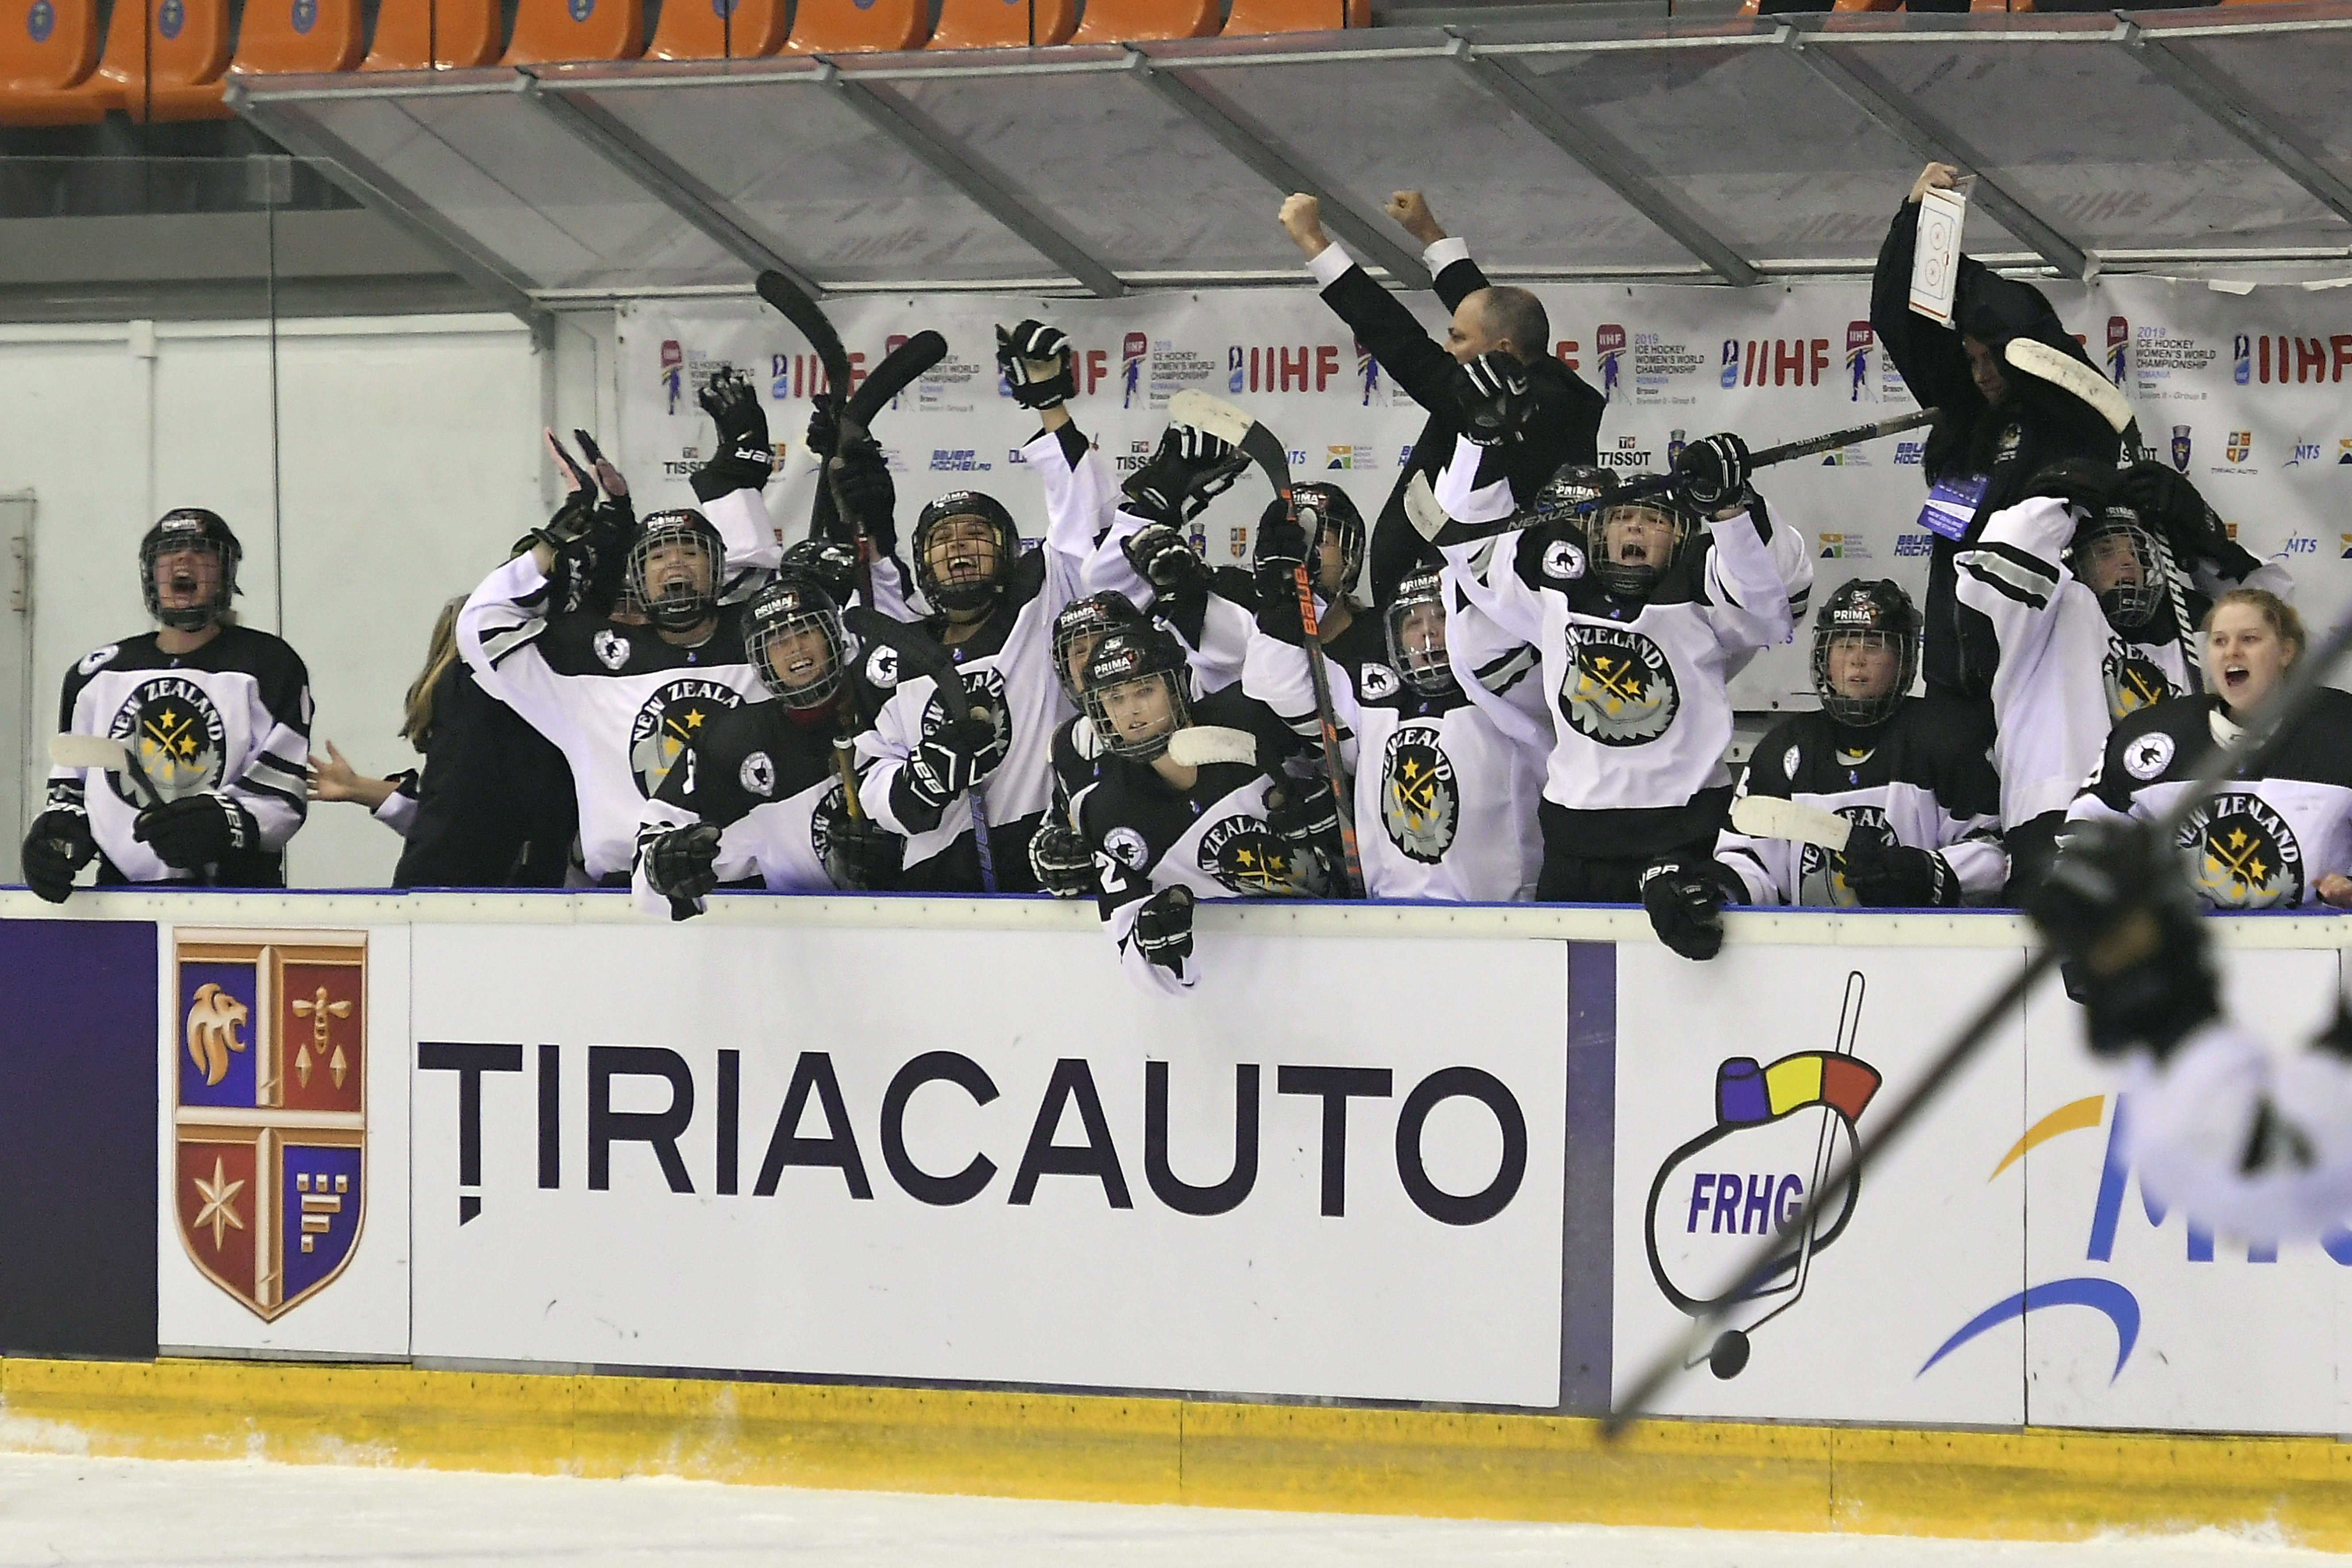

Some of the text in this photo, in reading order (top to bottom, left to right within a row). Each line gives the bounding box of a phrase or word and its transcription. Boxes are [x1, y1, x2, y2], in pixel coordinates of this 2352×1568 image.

[1599, 334, 1621, 344] IIHF
[1636, 334, 1658, 344] 2019
[2137, 327, 2165, 338] 2019
[1636, 345, 1686, 354] ICE HOCKEY
[2137, 339, 2195, 349] ICE HOCKEY
[1165, 352, 1197, 360] HOCKEY
[1636, 355, 1704, 364] WOMEN'S WORLD
[2136, 349, 2217, 359] WOMEN'S WORLD
[1249, 345, 1340, 393] IIHF
[1636, 365, 1697, 374] CHAMPIONSHIP
[1743, 339, 1830, 387] IIHF
[2136, 359, 2208, 369] CHAMPIONSHIP
[793, 352, 867, 398] IIF
[1599, 451, 1651, 466] TISSOT
[2295, 445, 2321, 460] MTS
[664, 462, 708, 474] TISSO
[1116, 457, 1151, 470] TISS
[1555, 485, 1594, 497] PRIMA
[1507, 507, 1577, 532] NEXUS
[2285, 539, 2317, 554] MTS
[1400, 576, 1439, 593] PRIMA
[754, 593, 793, 619] PRIMA
[1295, 562, 1318, 636] BAUE
[1060, 607, 1096, 627] PRIMA
[1834, 610, 1871, 620] PRIMA
[1581, 628, 1663, 670] ZELAND
[1094, 657, 1131, 676] PRIMA
[111, 678, 223, 743] NEW ZEALAND
[633, 682, 739, 743] NEW ZEALA
[1204, 817, 1268, 858] ZEALA
[1686, 1173, 1804, 1236] FRHG
